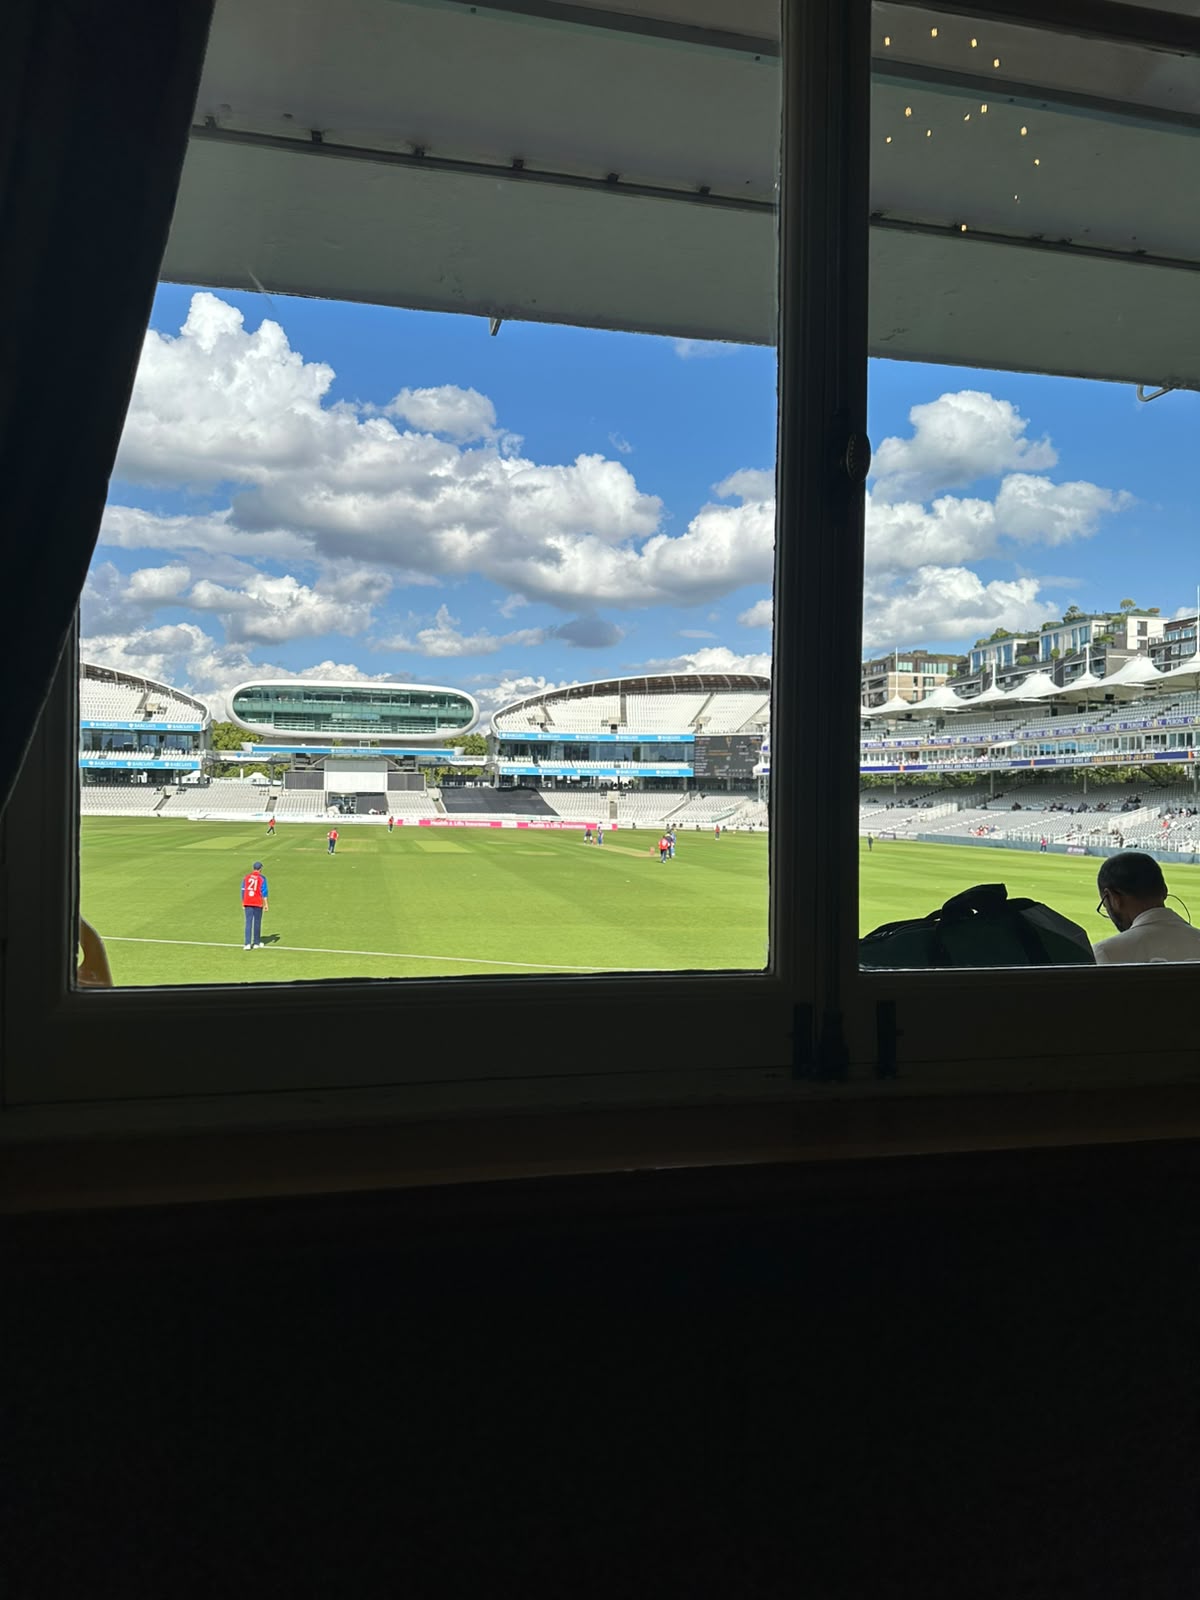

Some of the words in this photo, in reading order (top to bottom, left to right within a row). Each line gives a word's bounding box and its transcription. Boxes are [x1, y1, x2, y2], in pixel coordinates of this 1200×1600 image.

[1127, 721, 1144, 729] PERONI
[1166, 717, 1185, 726] PERONI
[247, 878, 258, 891] 21
